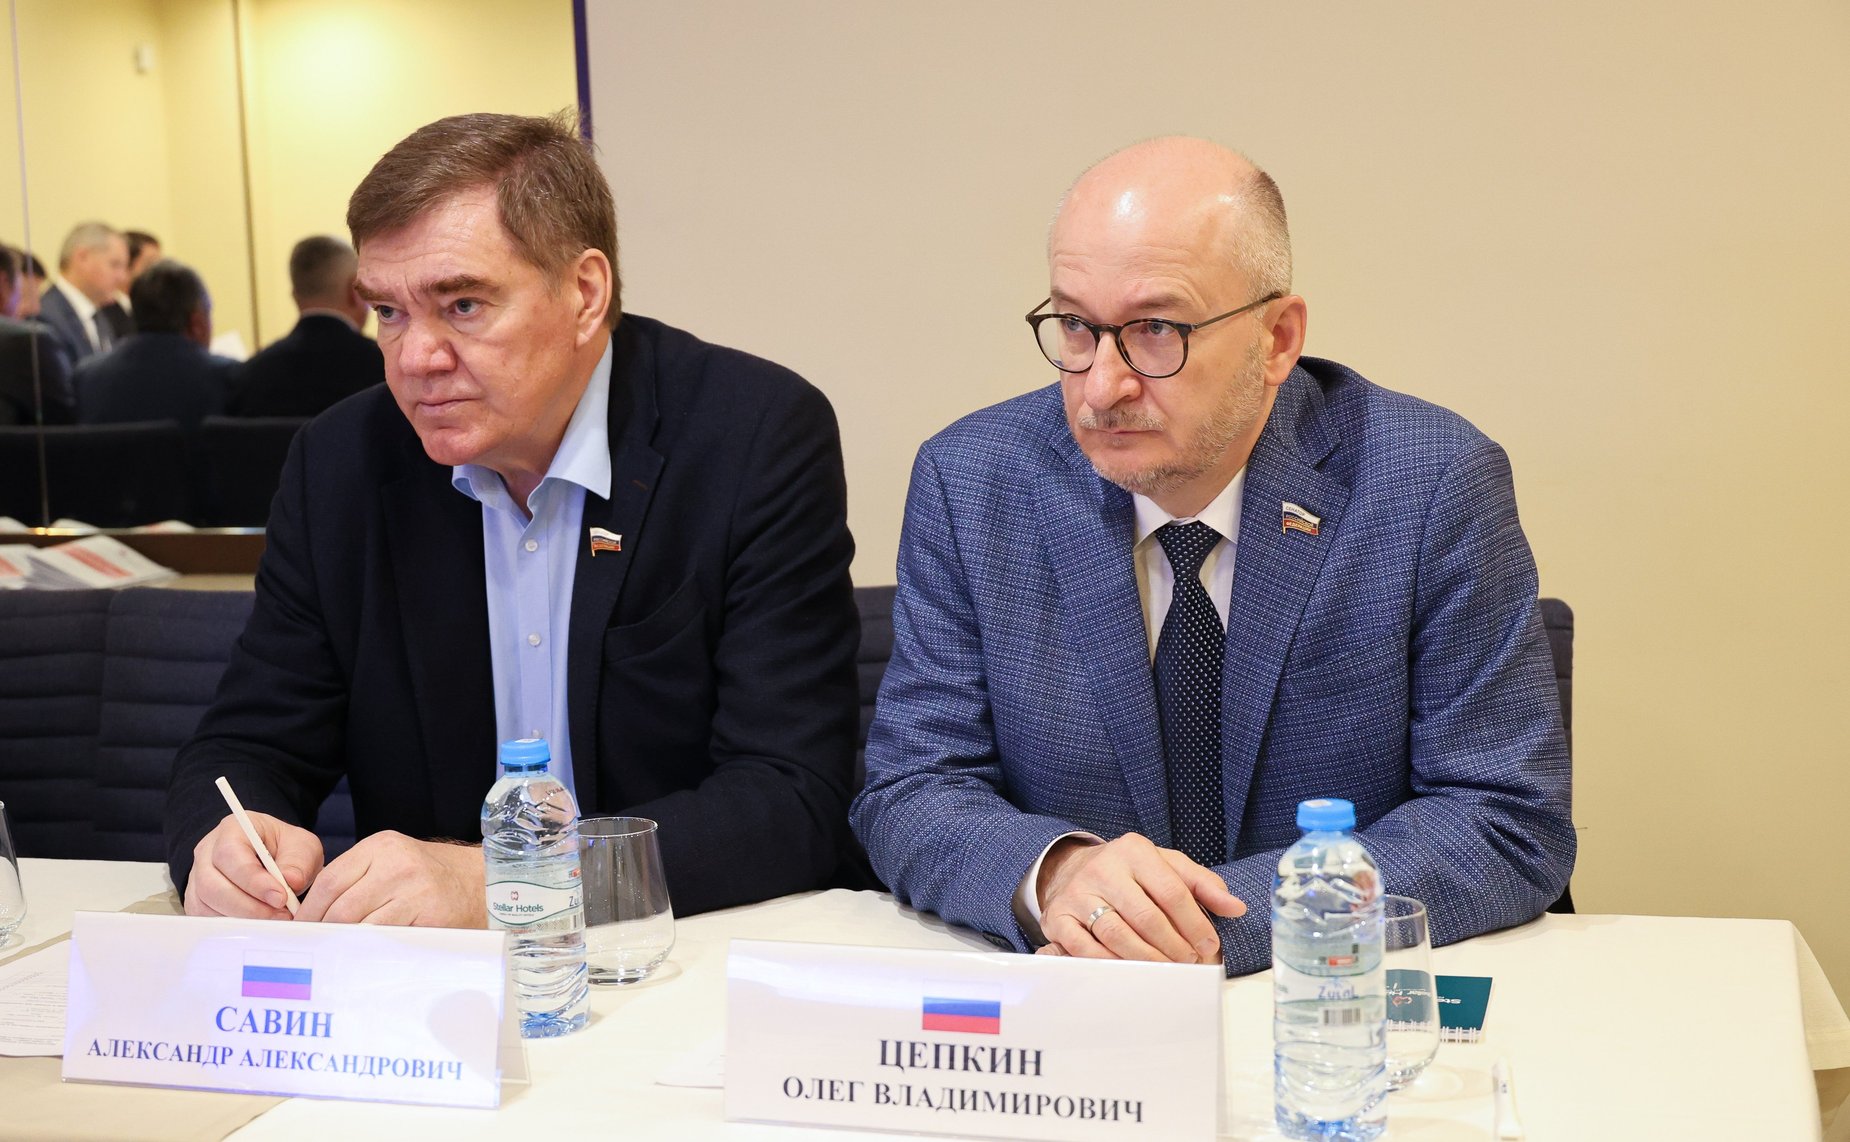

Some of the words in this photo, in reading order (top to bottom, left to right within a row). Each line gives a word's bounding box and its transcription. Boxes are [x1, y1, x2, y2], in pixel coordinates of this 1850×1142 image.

[493, 902, 514, 912] Stellar
[515, 903, 544, 913] Hotels
[214, 1005, 334, 1039] САВИН
[87, 1037, 234, 1068] АЛЕКСАНДР
[239, 1048, 463, 1081] АЛЕКСАНДРОВИЧ
[878, 1038, 1044, 1077] ЦЕПКИН
[782, 1075, 865, 1103] ОЛЕГ
[873, 1082, 1144, 1123] ВЛАДИМИРОВИЧ
